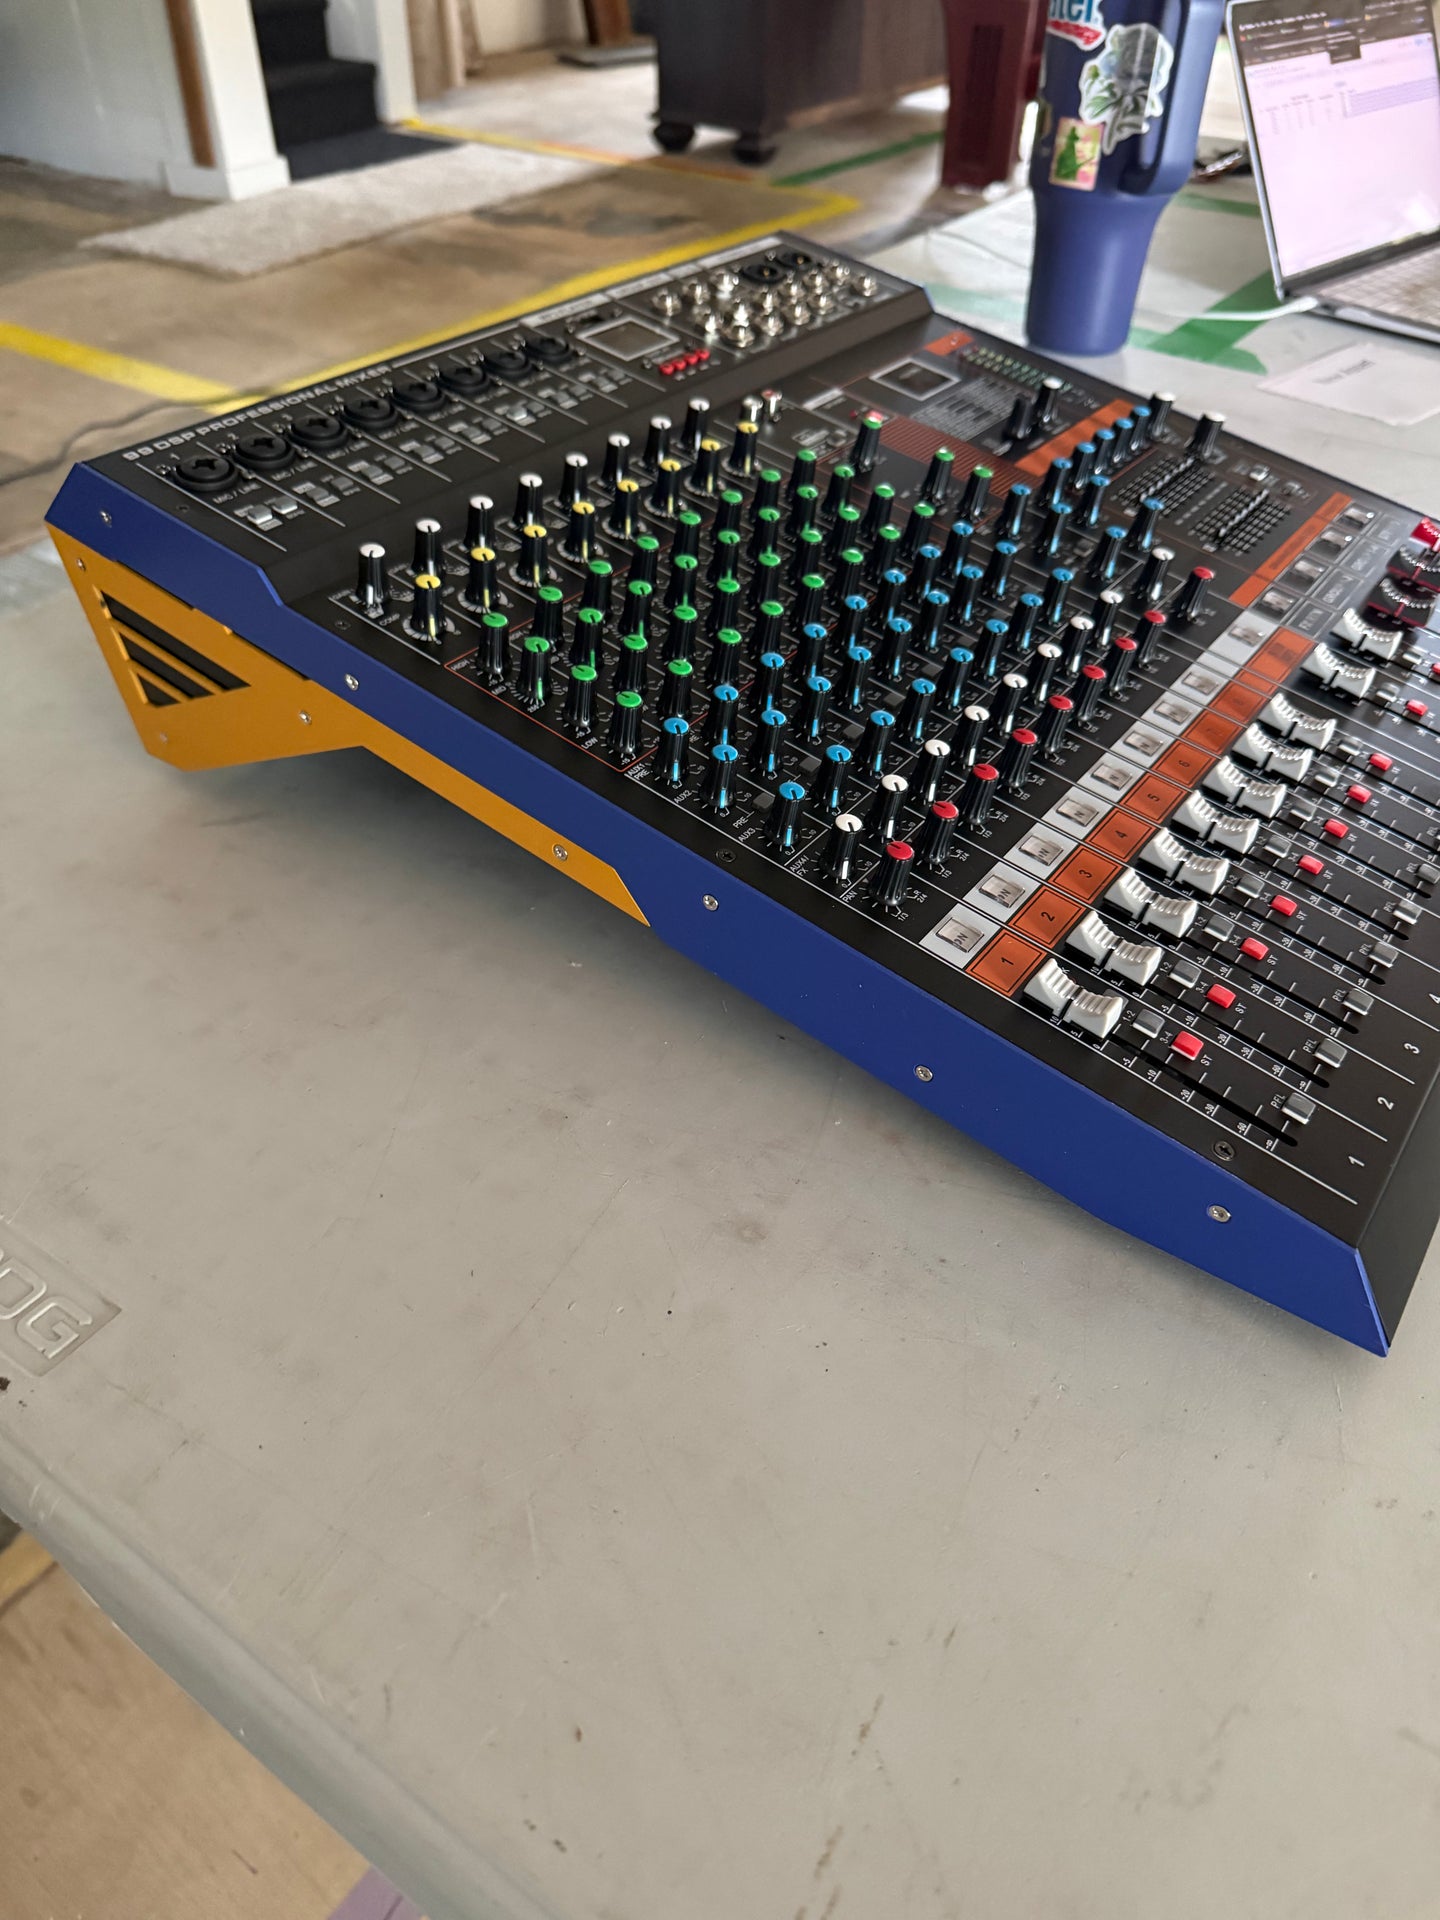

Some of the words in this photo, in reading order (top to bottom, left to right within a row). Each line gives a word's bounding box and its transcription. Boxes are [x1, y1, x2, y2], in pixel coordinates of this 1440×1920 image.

[153, 430, 196, 451] DSP
[196, 385, 338, 436] PROFESSIONAL
[337, 364, 394, 389] MIXER
[581, 737, 599, 750] LOW
[627, 763, 646, 777] AUX1
[633, 769, 650, 781] PRE
[673, 789, 693, 805] AUX2
[1147, 793, 1161, 803] 5
[732, 817, 749, 829] PRE
[738, 828, 757, 843] AUX3
[1115, 829, 1128, 839] 4
[798, 867, 810, 878] FX
[1078, 869, 1093, 879] 3
[842, 890, 859, 903] PAN
[916, 893, 928, 904] 2/4
[898, 912, 909, 922] 1/3
[1040, 911, 1055, 923] 2
[1195, 916, 1207, 927] 1-2
[1296, 910, 1309, 921] ST
[1229, 935, 1242, 946] 3-4
[1359, 943, 1372, 955] PFL
[1000, 956, 1014, 967] 1
[1267, 954, 1279, 966] ST
[1159, 961, 1173, 974] 1-2
[1195, 981, 1209, 994] 3-4
[1332, 988, 1347, 1002] PFL
[1235, 1002, 1248, 1014] ST
[1122, 1009, 1136, 1023] 1-2
[1159, 1030, 1174, 1045] 3-4
[1302, 1038, 1318, 1053] PFL
[1404, 1042, 1420, 1054] 3
[1123, 1057, 1132, 1066] -5
[1200, 1054, 1213, 1066] ST
[1147, 1069, 1158, 1081] -10
[1180, 1089, 1191, 1101] -20
[1270, 1093, 1286, 1110] PFL
[1377, 1096, 1394, 1110] 2
[1348, 1155, 1366, 1168] 1
[0, 1256, 93, 1359] DG
